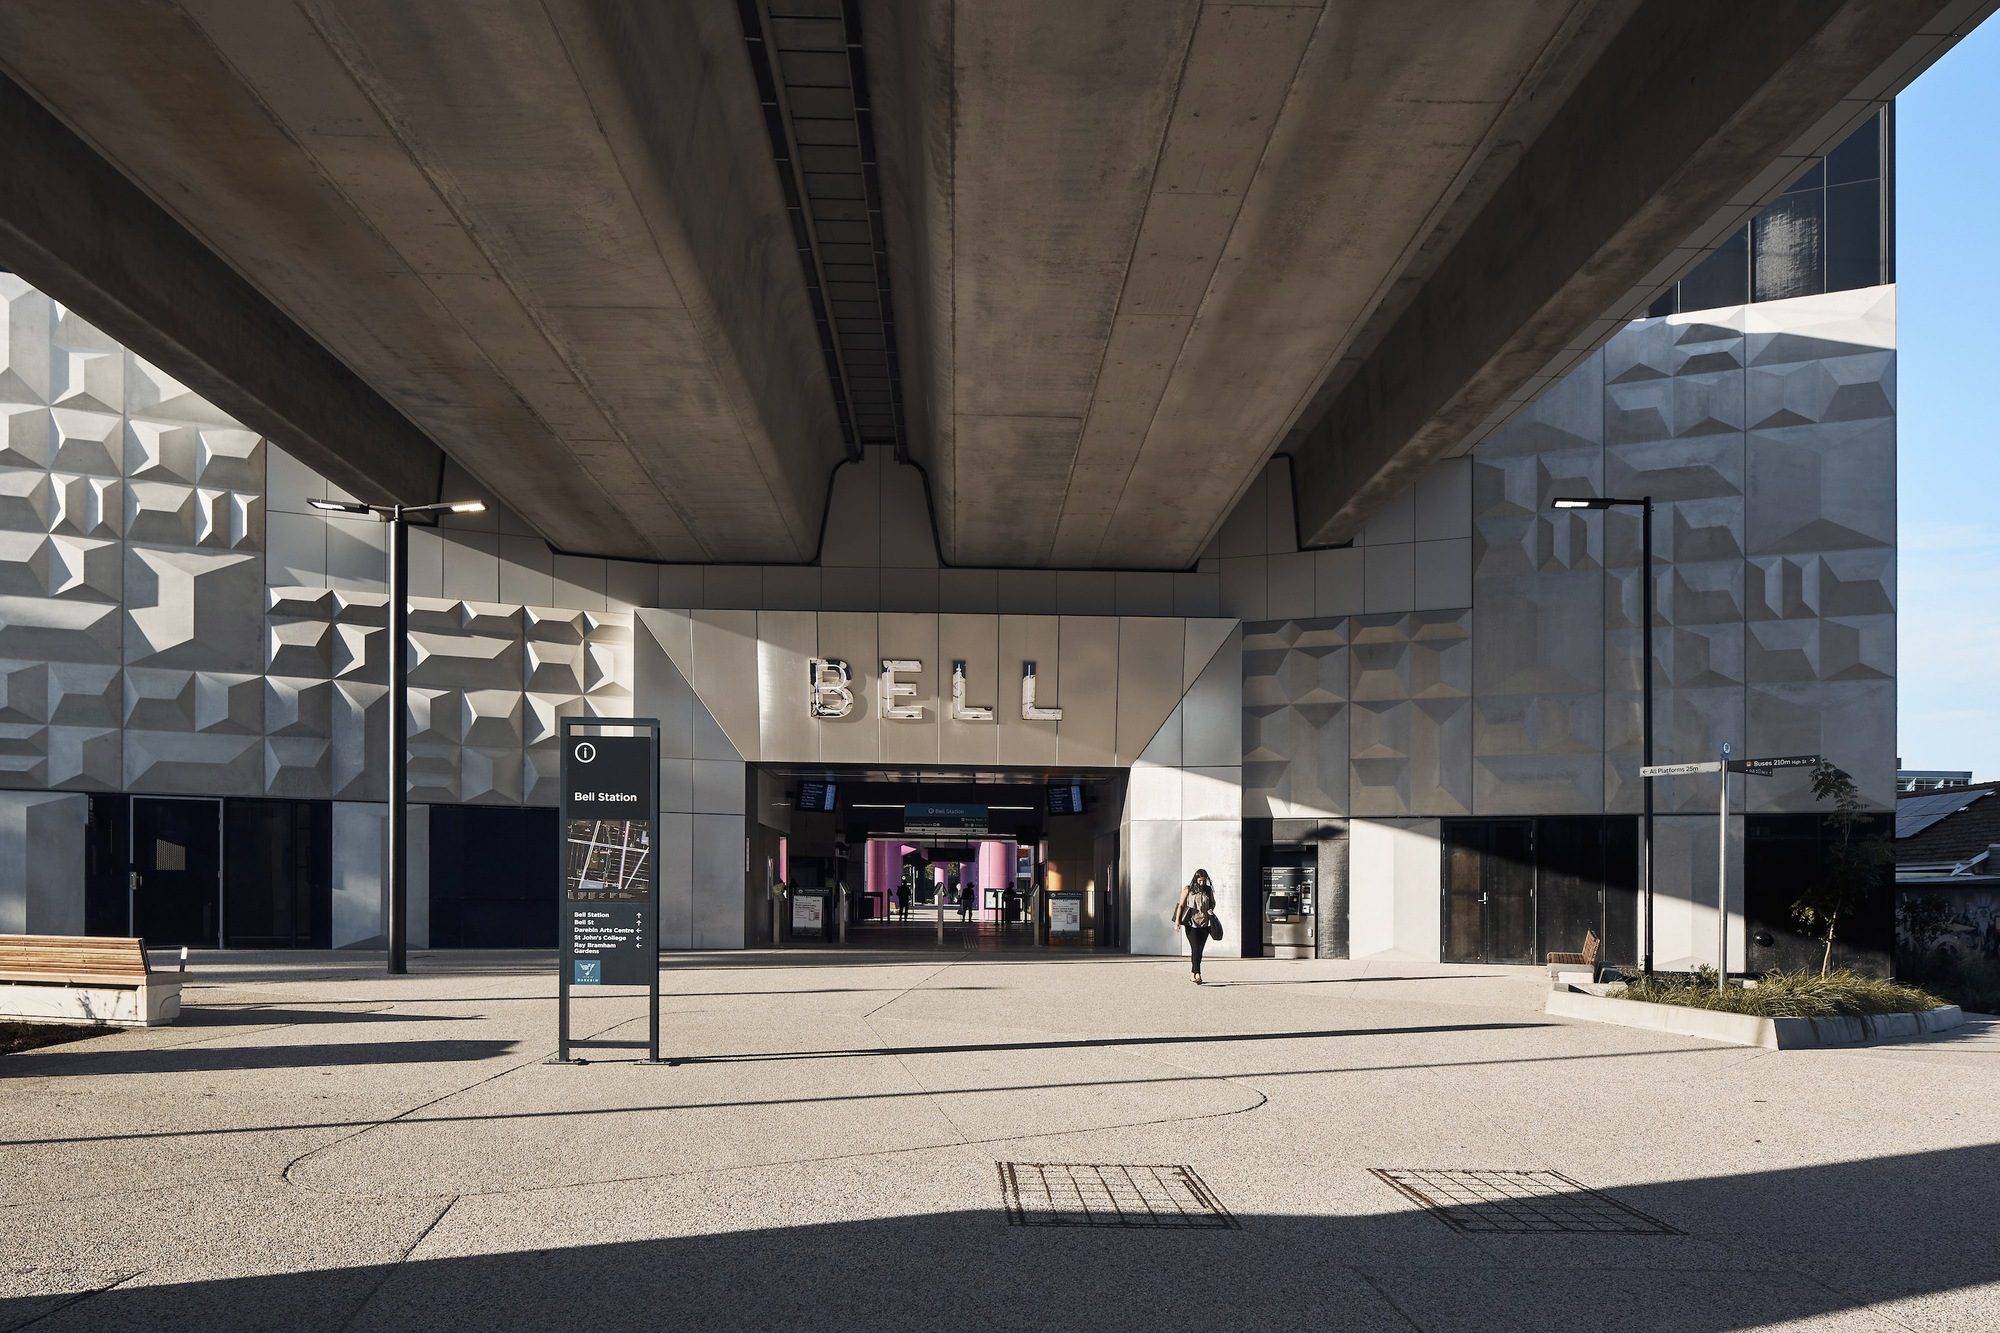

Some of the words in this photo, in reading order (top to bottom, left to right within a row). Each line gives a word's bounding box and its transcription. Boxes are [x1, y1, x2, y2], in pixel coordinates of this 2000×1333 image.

[809, 658, 1063, 720] BELL
[1657, 766, 1685, 774] Platforms
[574, 791, 595, 802] Bell
[598, 792, 637, 802] Station
